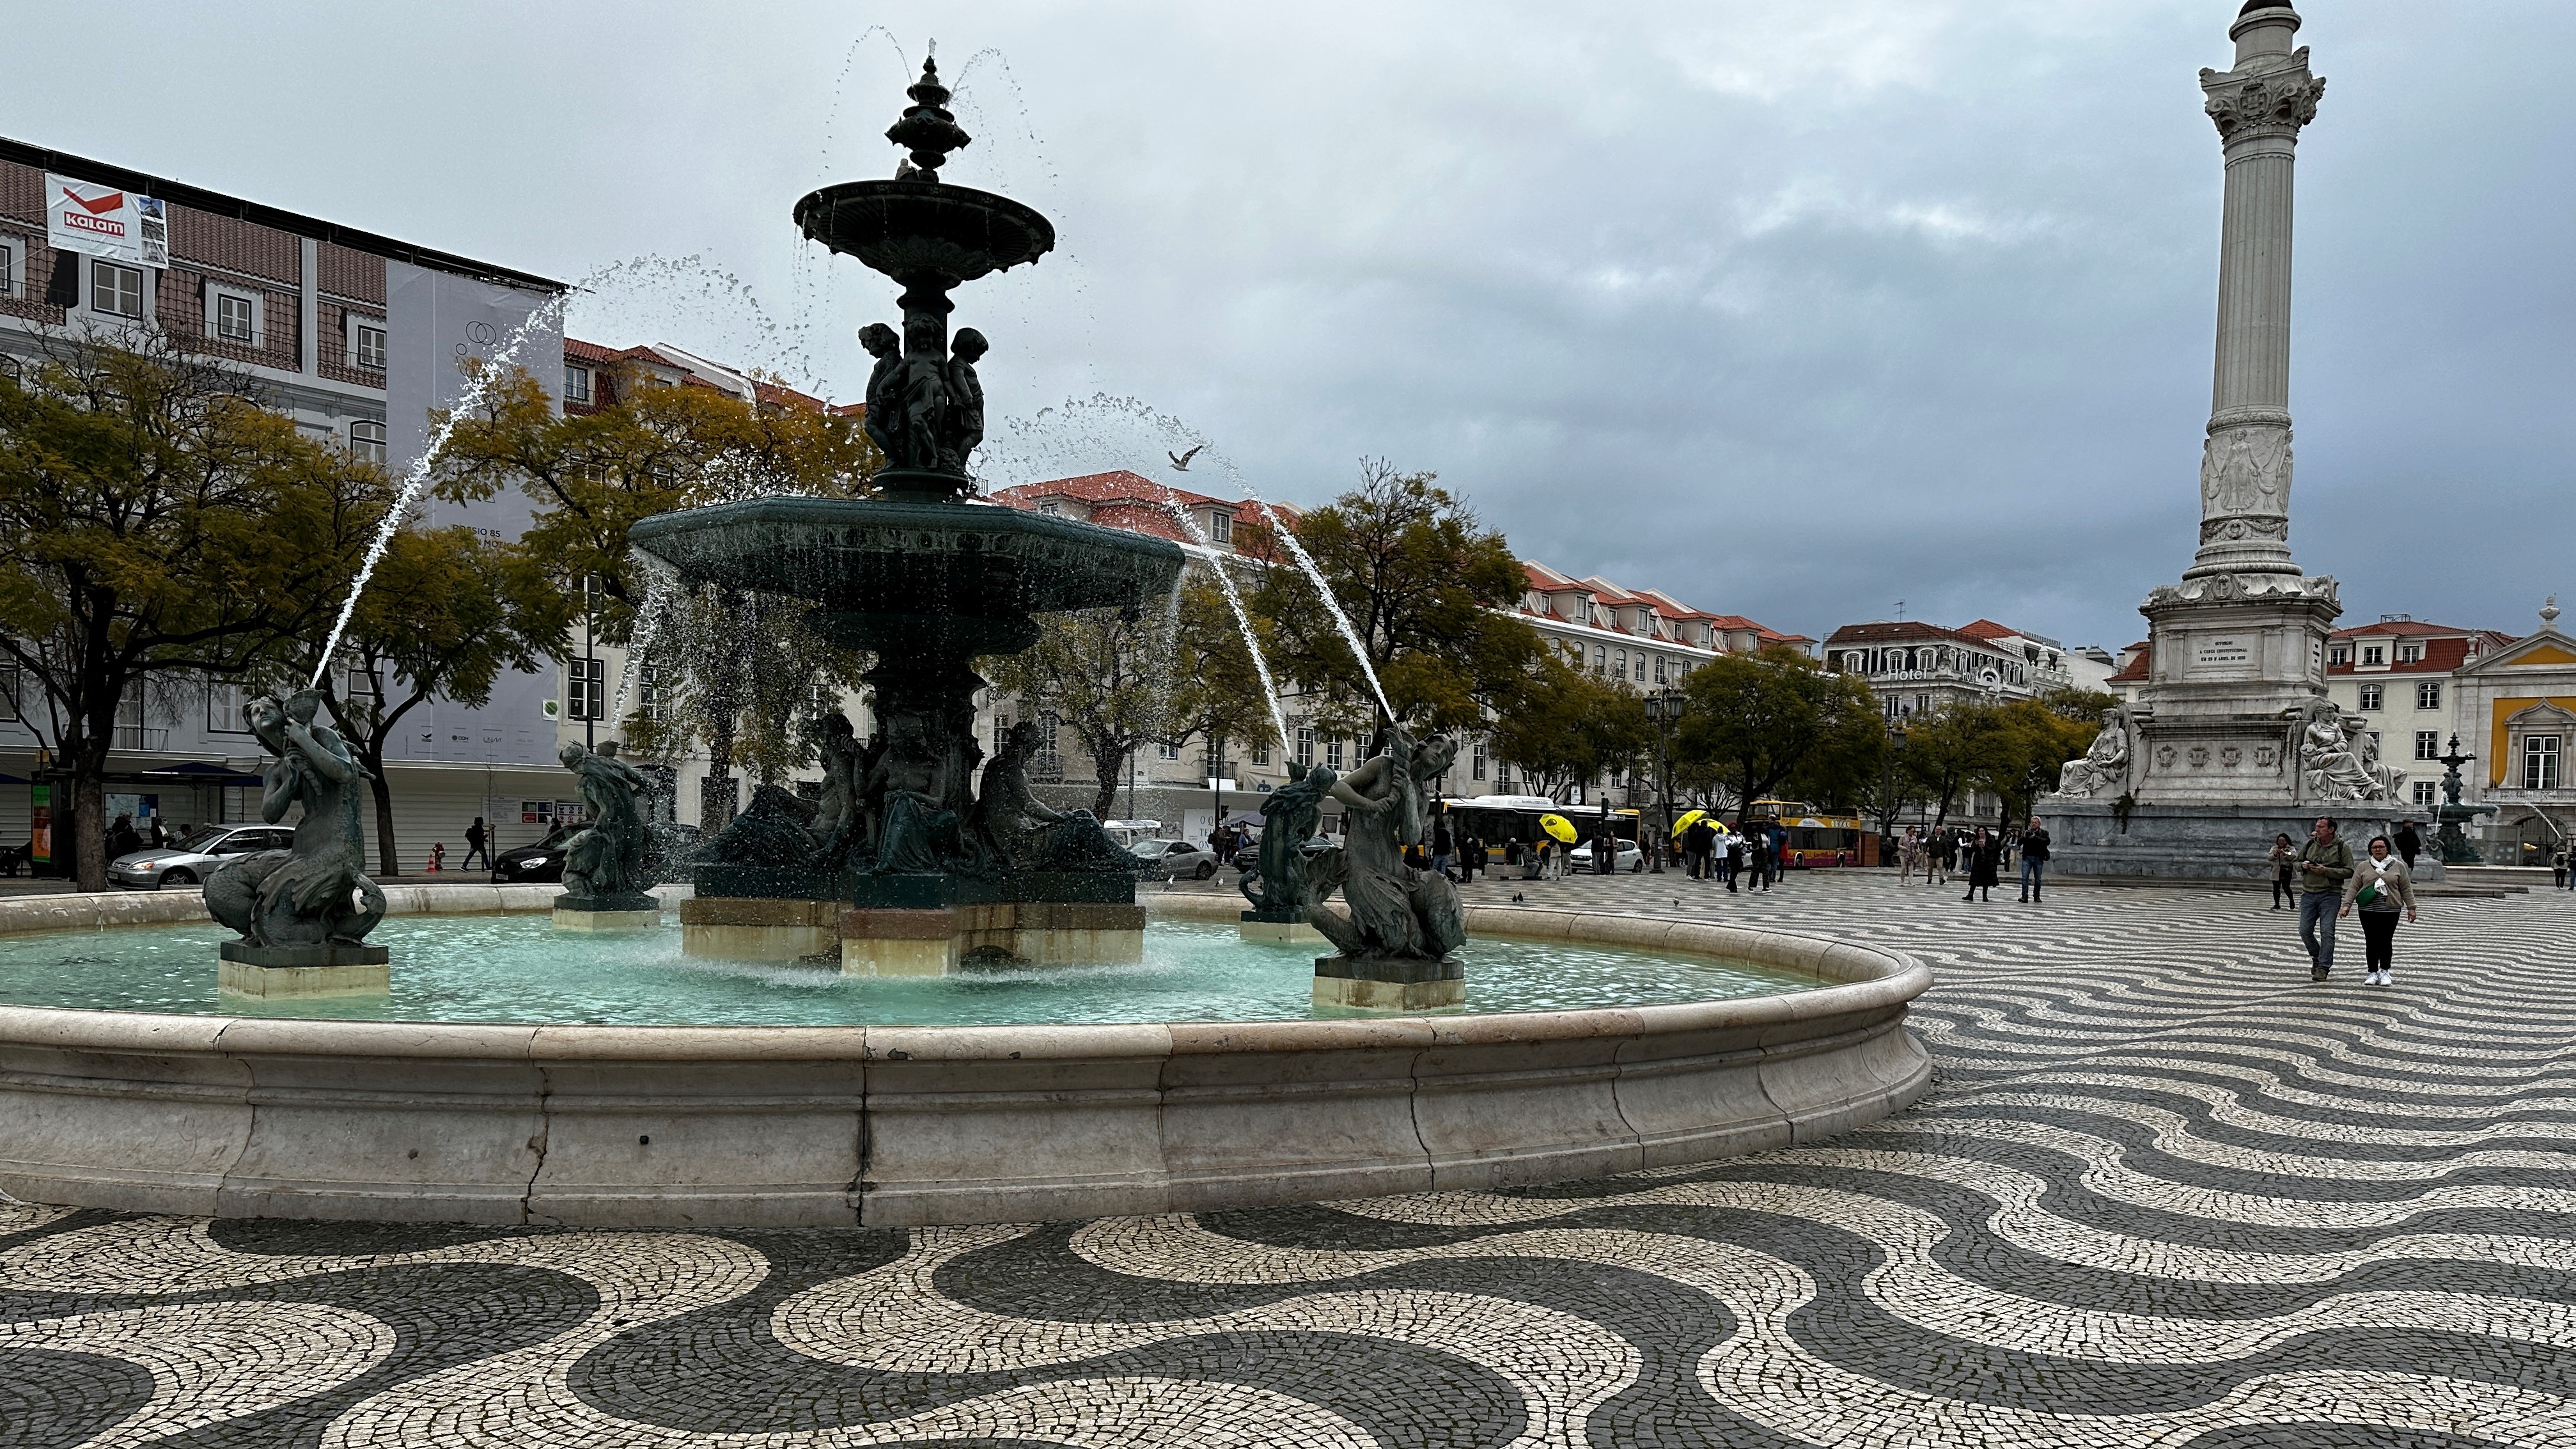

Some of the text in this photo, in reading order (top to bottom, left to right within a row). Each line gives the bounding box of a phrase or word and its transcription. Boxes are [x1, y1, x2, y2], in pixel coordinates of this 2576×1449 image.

[490, 529, 501, 538] 85
[1888, 668, 1927, 680] Hotel
[1200, 816, 1206, 824] O
